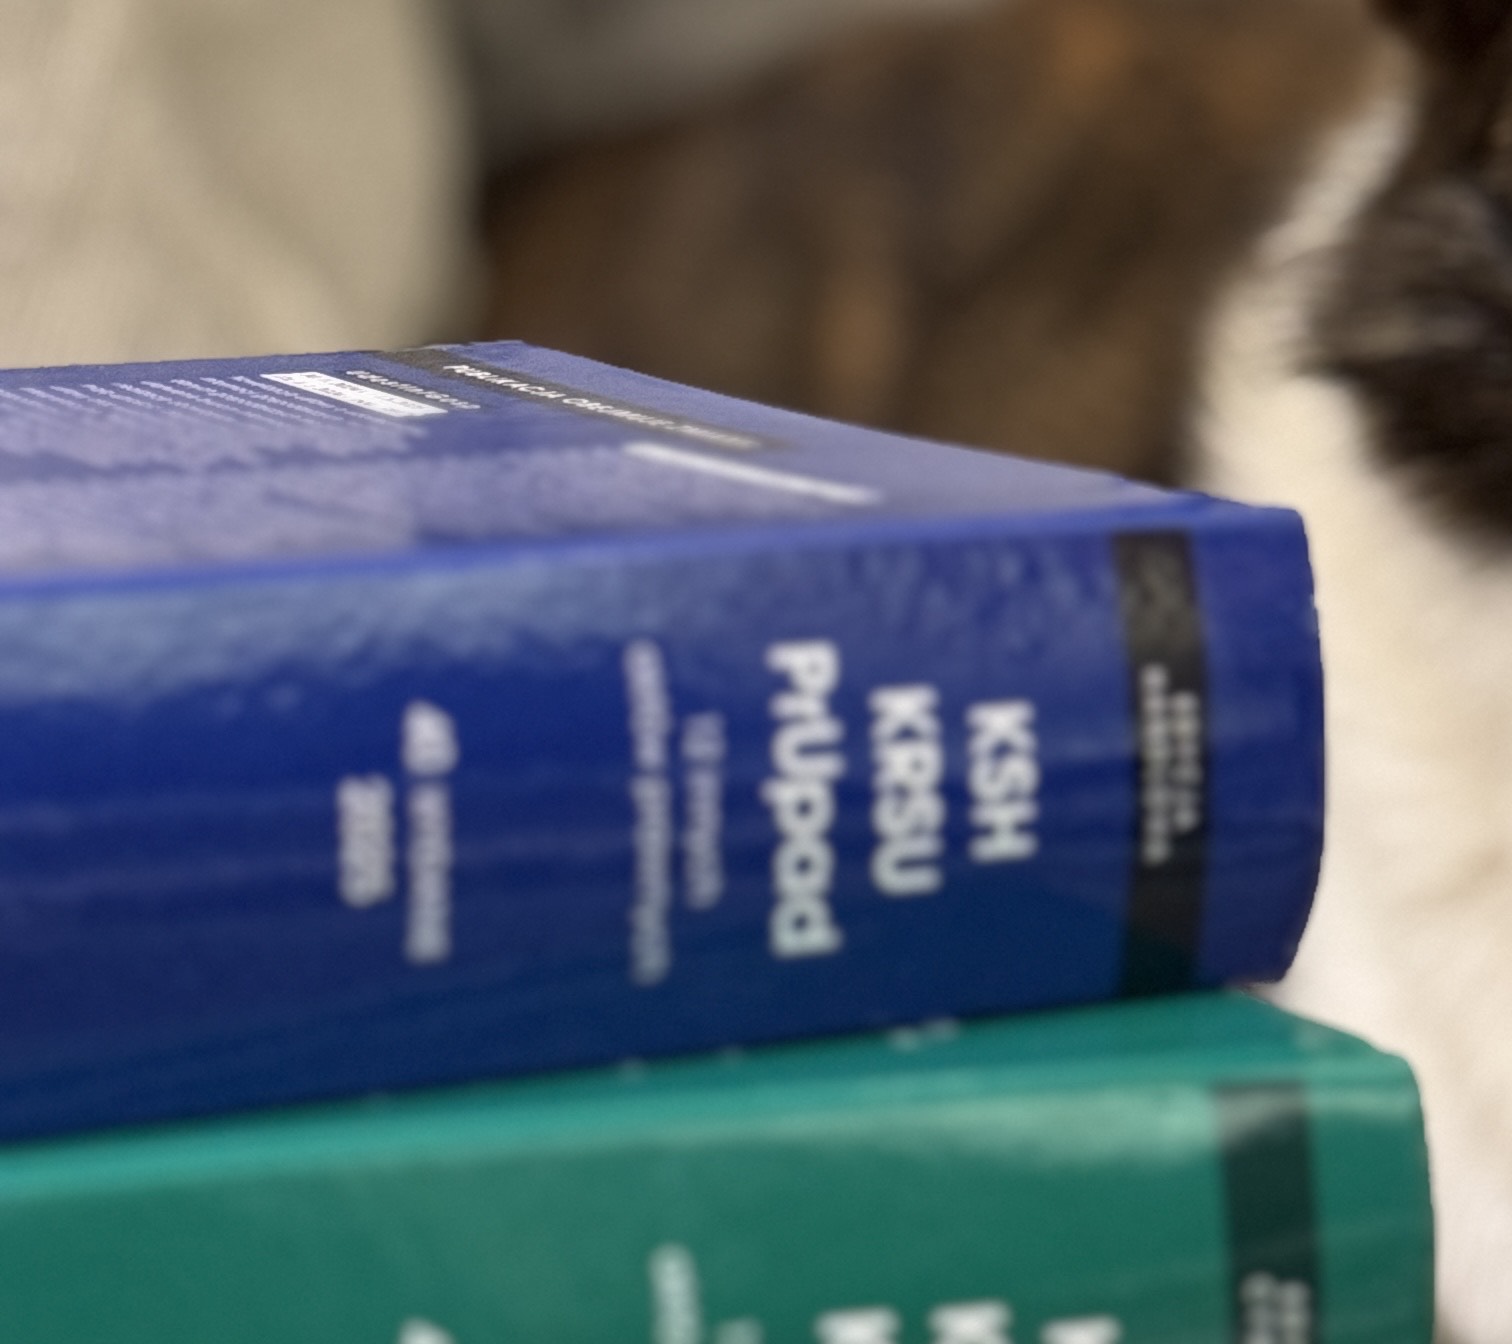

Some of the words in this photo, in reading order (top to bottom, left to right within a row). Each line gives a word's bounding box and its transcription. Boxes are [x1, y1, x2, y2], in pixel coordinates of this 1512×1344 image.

[764, 640, 844, 954] PrUpad
[871, 685, 943, 892] KRSU
[968, 701, 1037, 859] KSH
